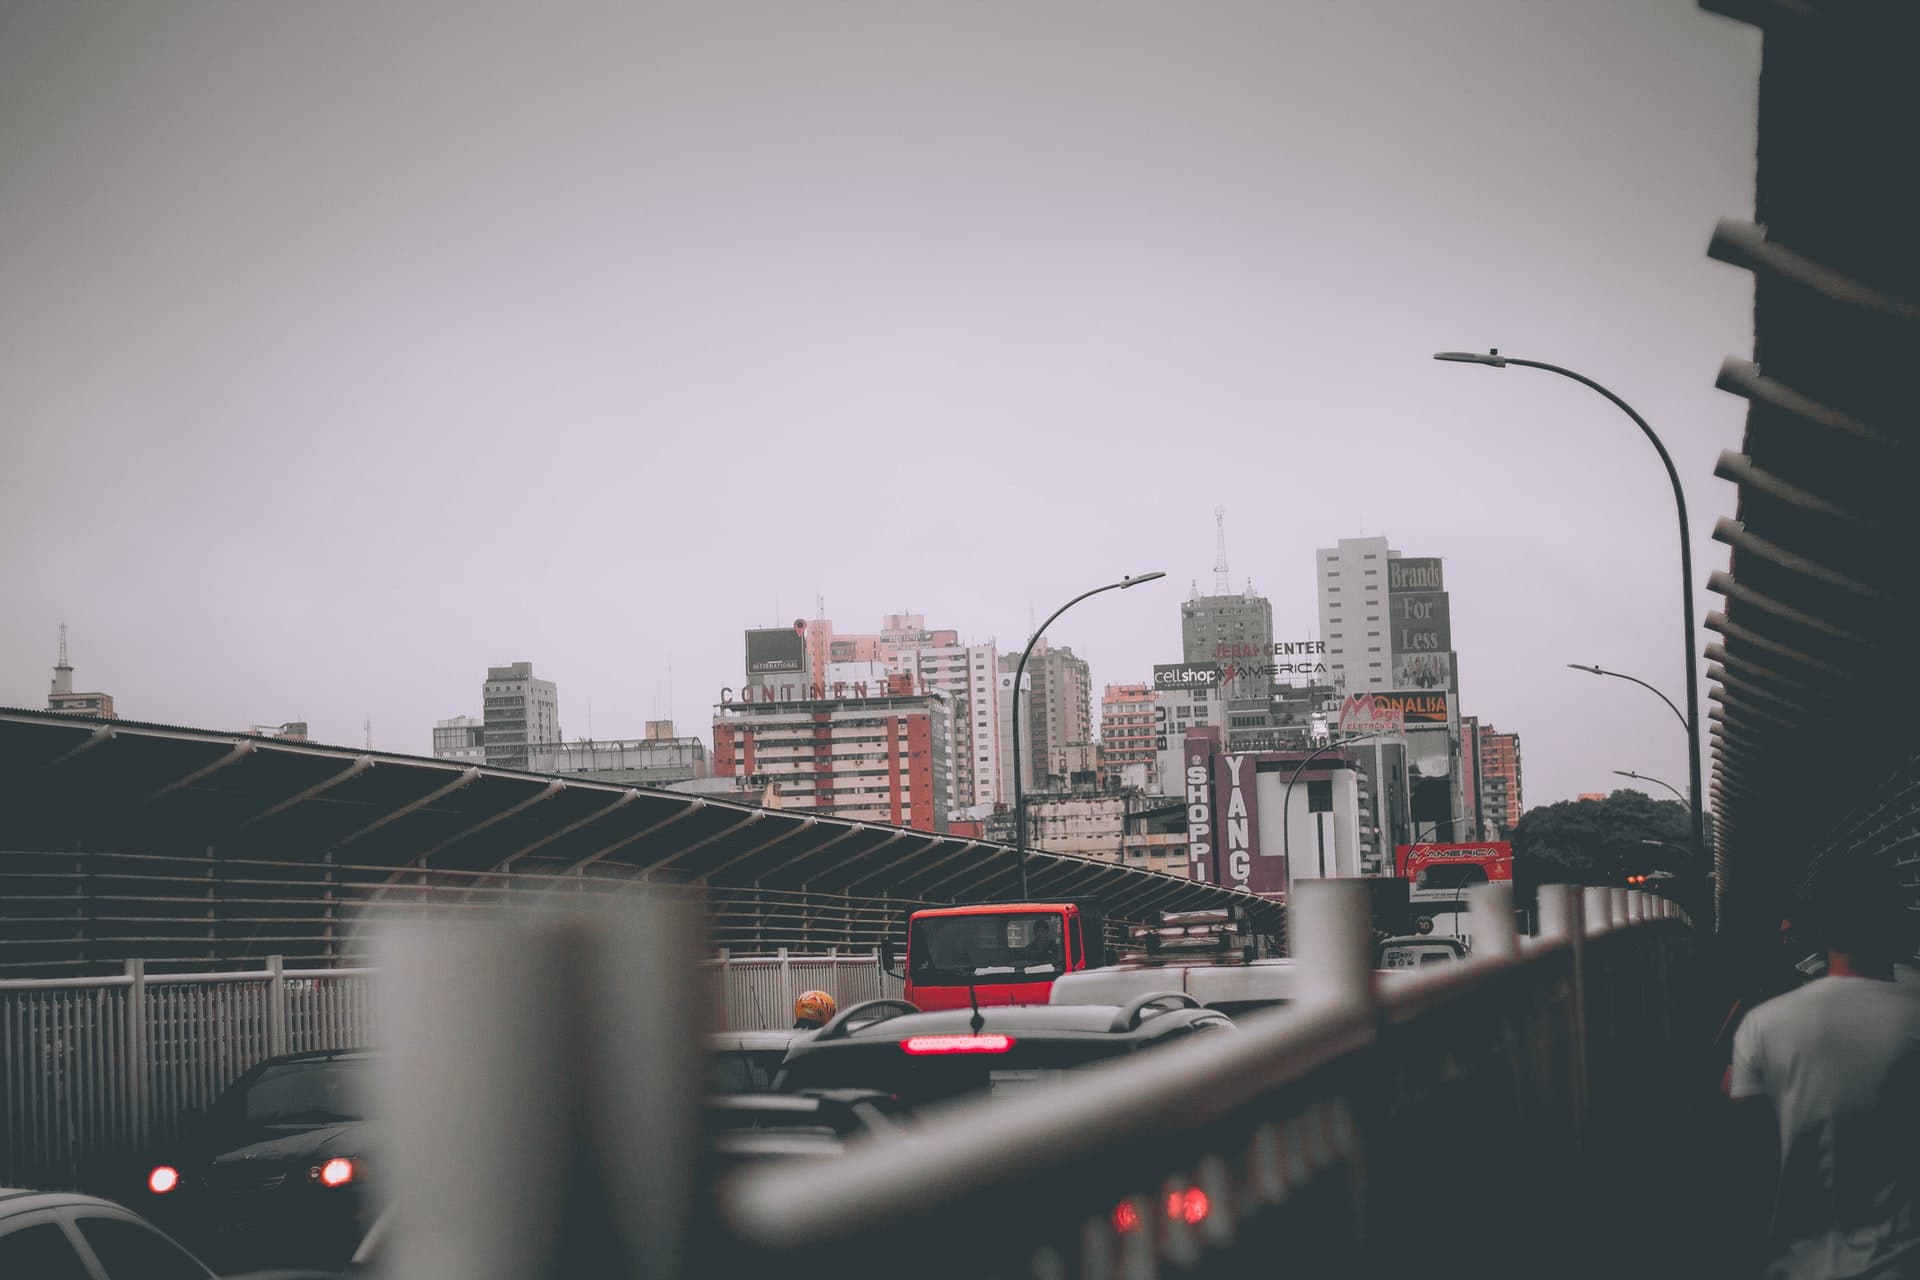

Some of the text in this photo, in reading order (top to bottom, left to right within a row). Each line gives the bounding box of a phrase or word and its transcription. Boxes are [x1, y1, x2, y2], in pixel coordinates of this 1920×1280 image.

[1390, 561, 1440, 588] Brands
[1403, 597, 1433, 619] For
[1264, 641, 1326, 657] CENTER
[1402, 629, 1438, 650] Less
[1154, 668, 1217, 685] cellshop
[721, 679, 933, 704] CONTINENTL
[1373, 695, 1446, 713] ONALISA
[1187, 767, 1210, 882] SHOPPI
